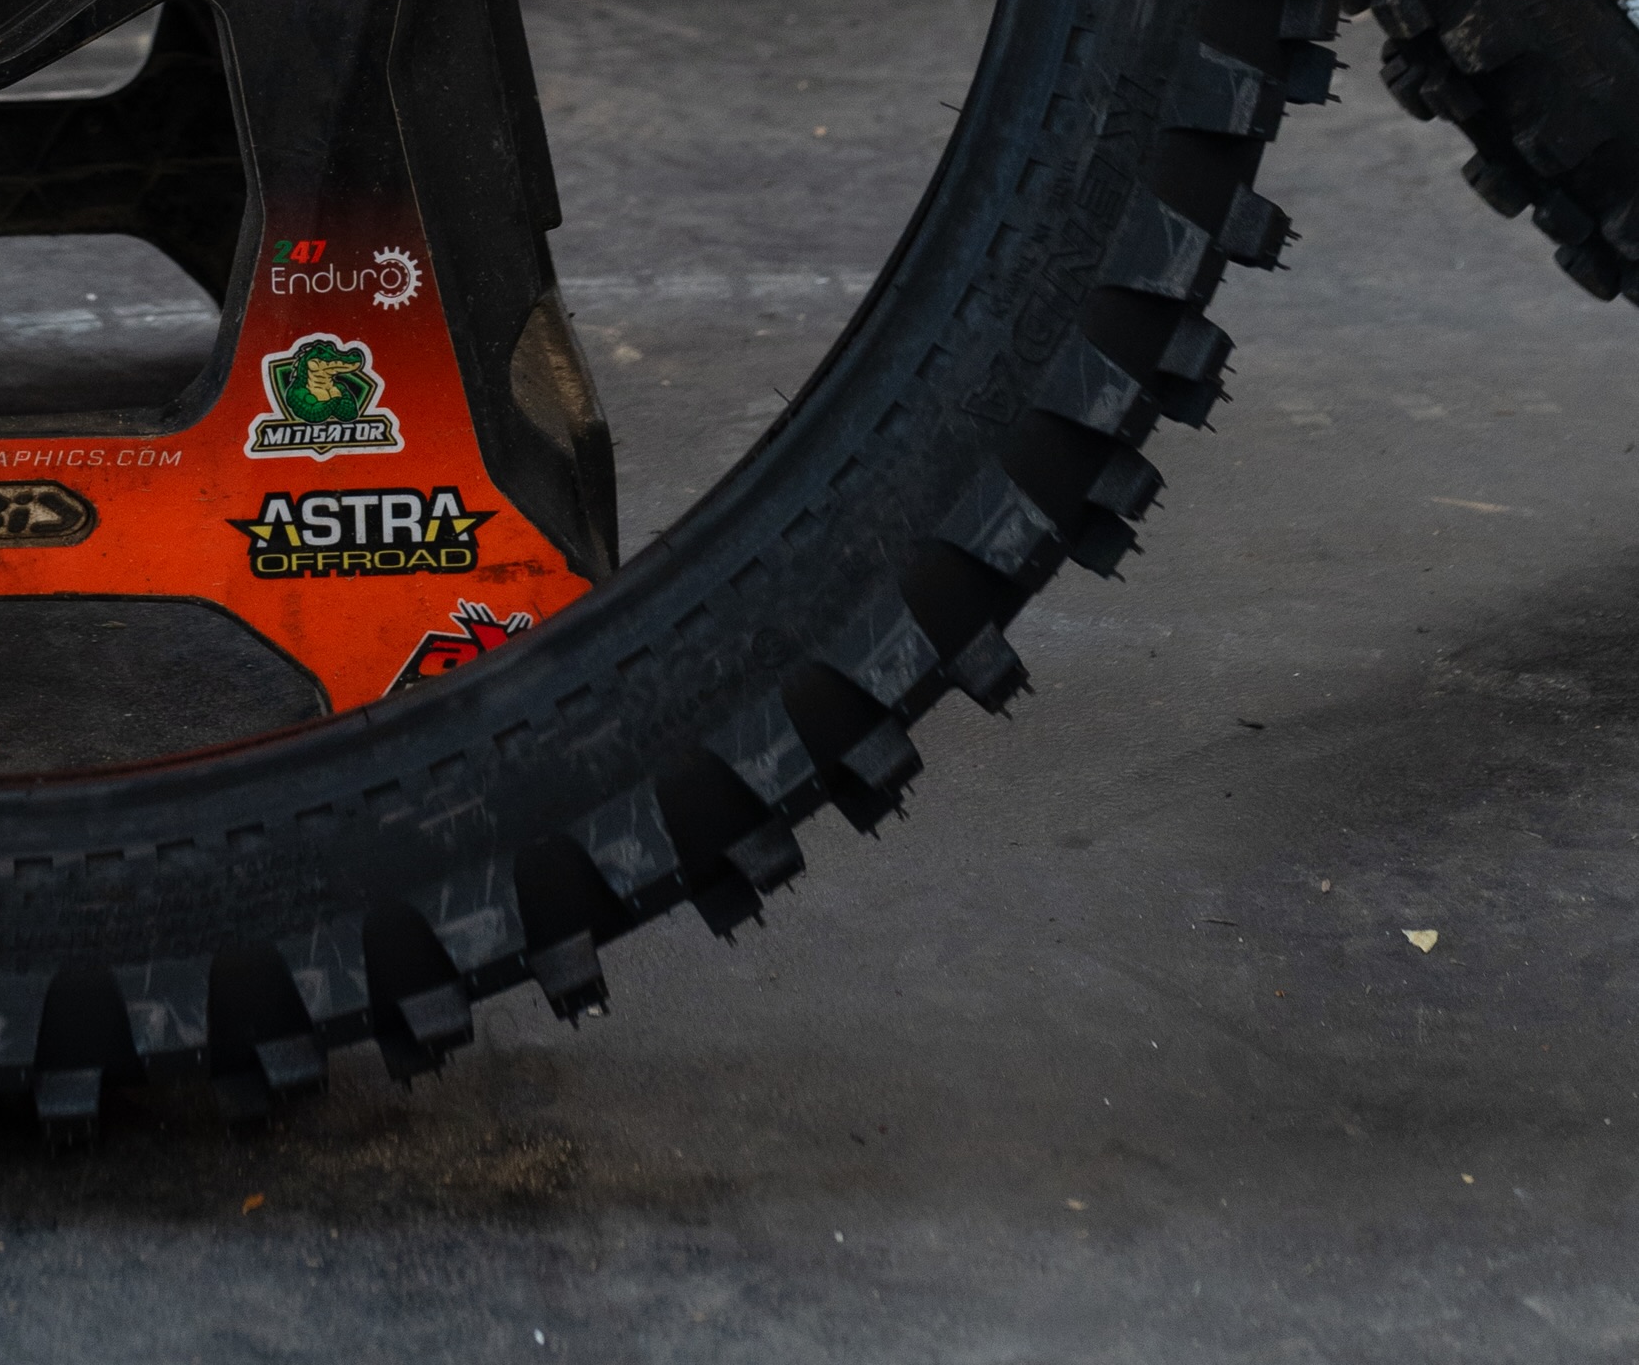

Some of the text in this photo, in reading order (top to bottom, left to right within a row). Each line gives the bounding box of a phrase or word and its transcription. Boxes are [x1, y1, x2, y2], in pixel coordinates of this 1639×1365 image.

[272, 239, 327, 265] 247
[271, 258, 414, 300] Enduro
[262, 419, 387, 446] MITIGATOR
[248, 491, 476, 549] ASTRA
[256, 547, 472, 573] OFFROAD
